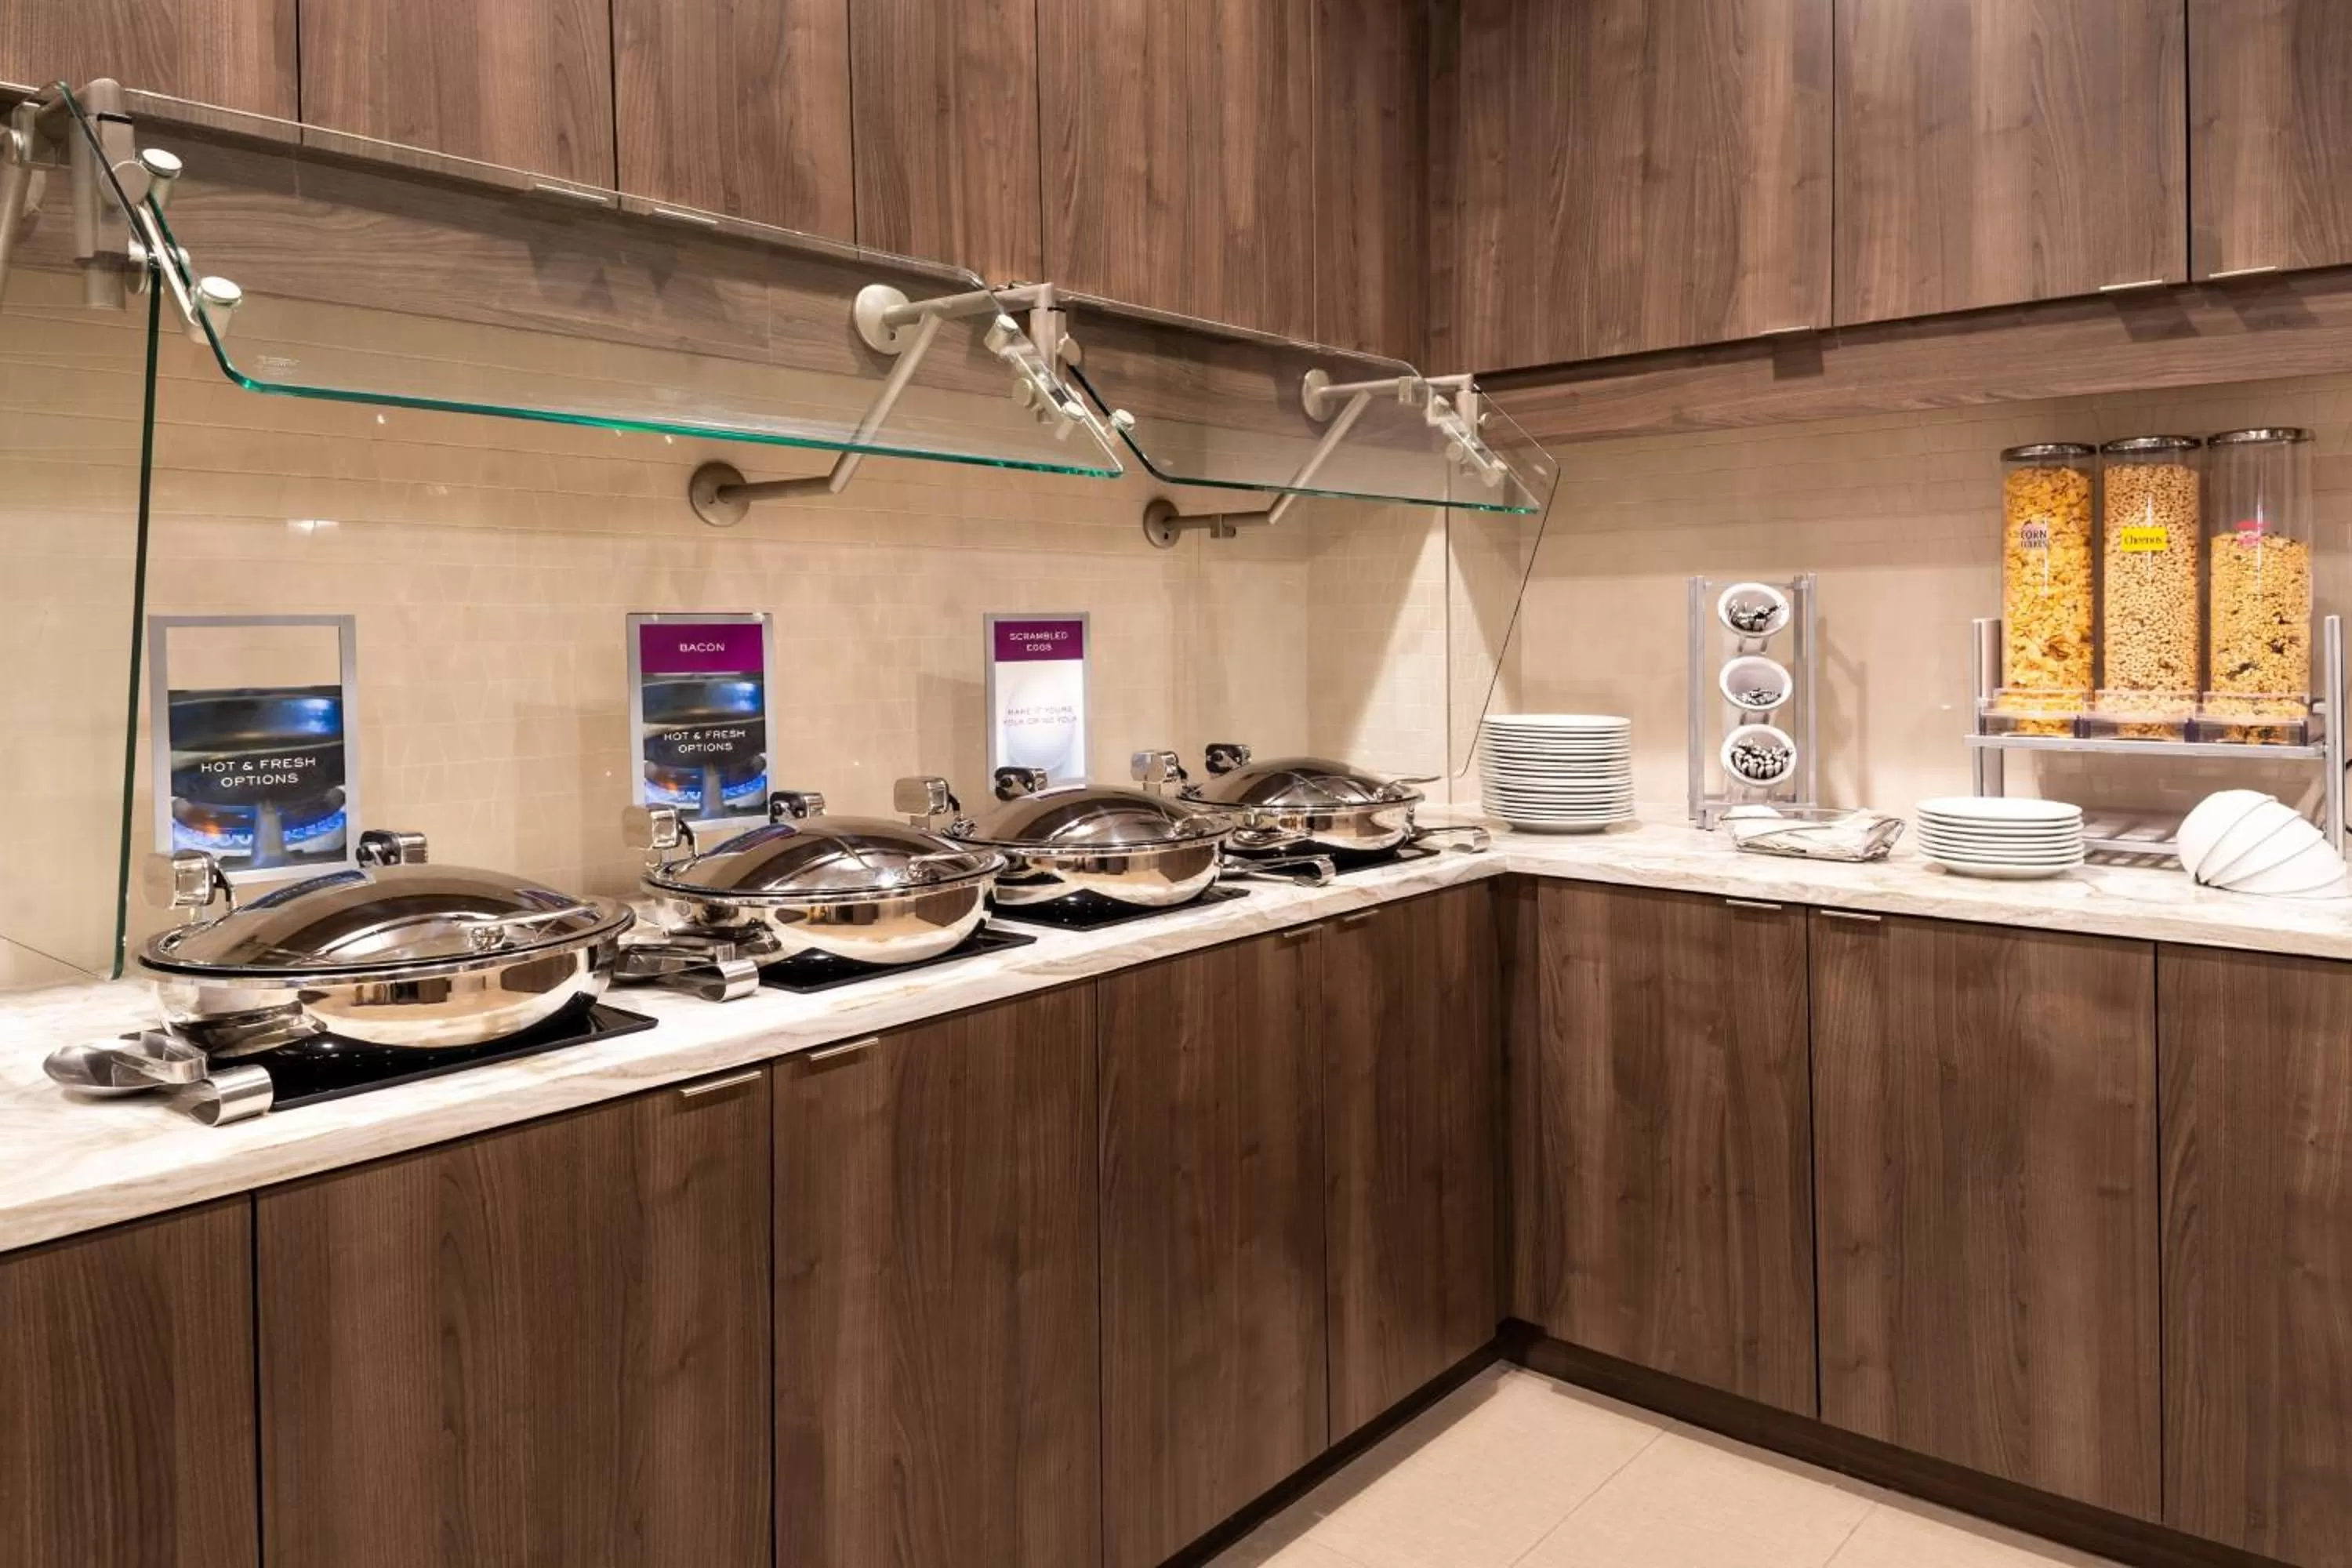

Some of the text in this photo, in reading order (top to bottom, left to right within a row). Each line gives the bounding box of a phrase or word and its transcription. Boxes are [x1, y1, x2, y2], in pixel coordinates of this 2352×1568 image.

[2020, 529, 2047, 539] CORN
[1009, 630, 1069, 641] SCRAMBLED
[680, 642, 725, 652] BACON
[1026, 643, 1053, 652] EGGS
[664, 728, 746, 741] HOT & FRESH
[678, 742, 733, 753] OPTIONS
[201, 756, 316, 773] HOT & FRESH
[220, 772, 299, 788] OPTIONS
